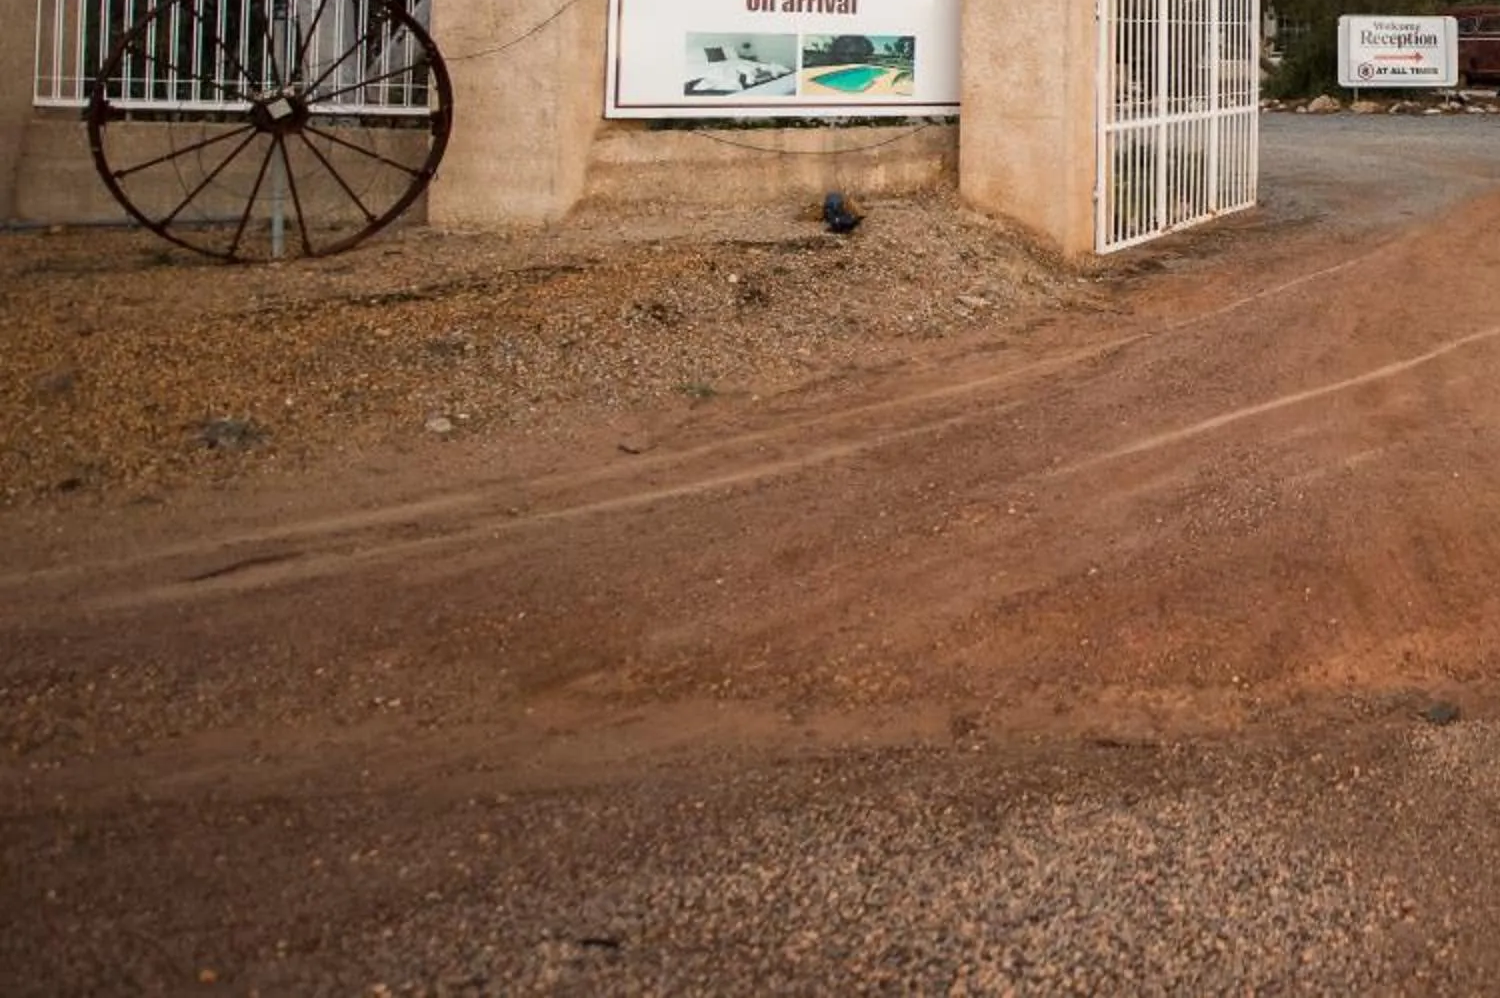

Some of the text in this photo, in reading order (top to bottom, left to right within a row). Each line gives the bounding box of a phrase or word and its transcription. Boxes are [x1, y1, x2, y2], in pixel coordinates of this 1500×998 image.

[1361, 29, 1437, 48] Reception
[1376, 67, 1389, 75] AT
[1390, 67, 1408, 75] ALL
